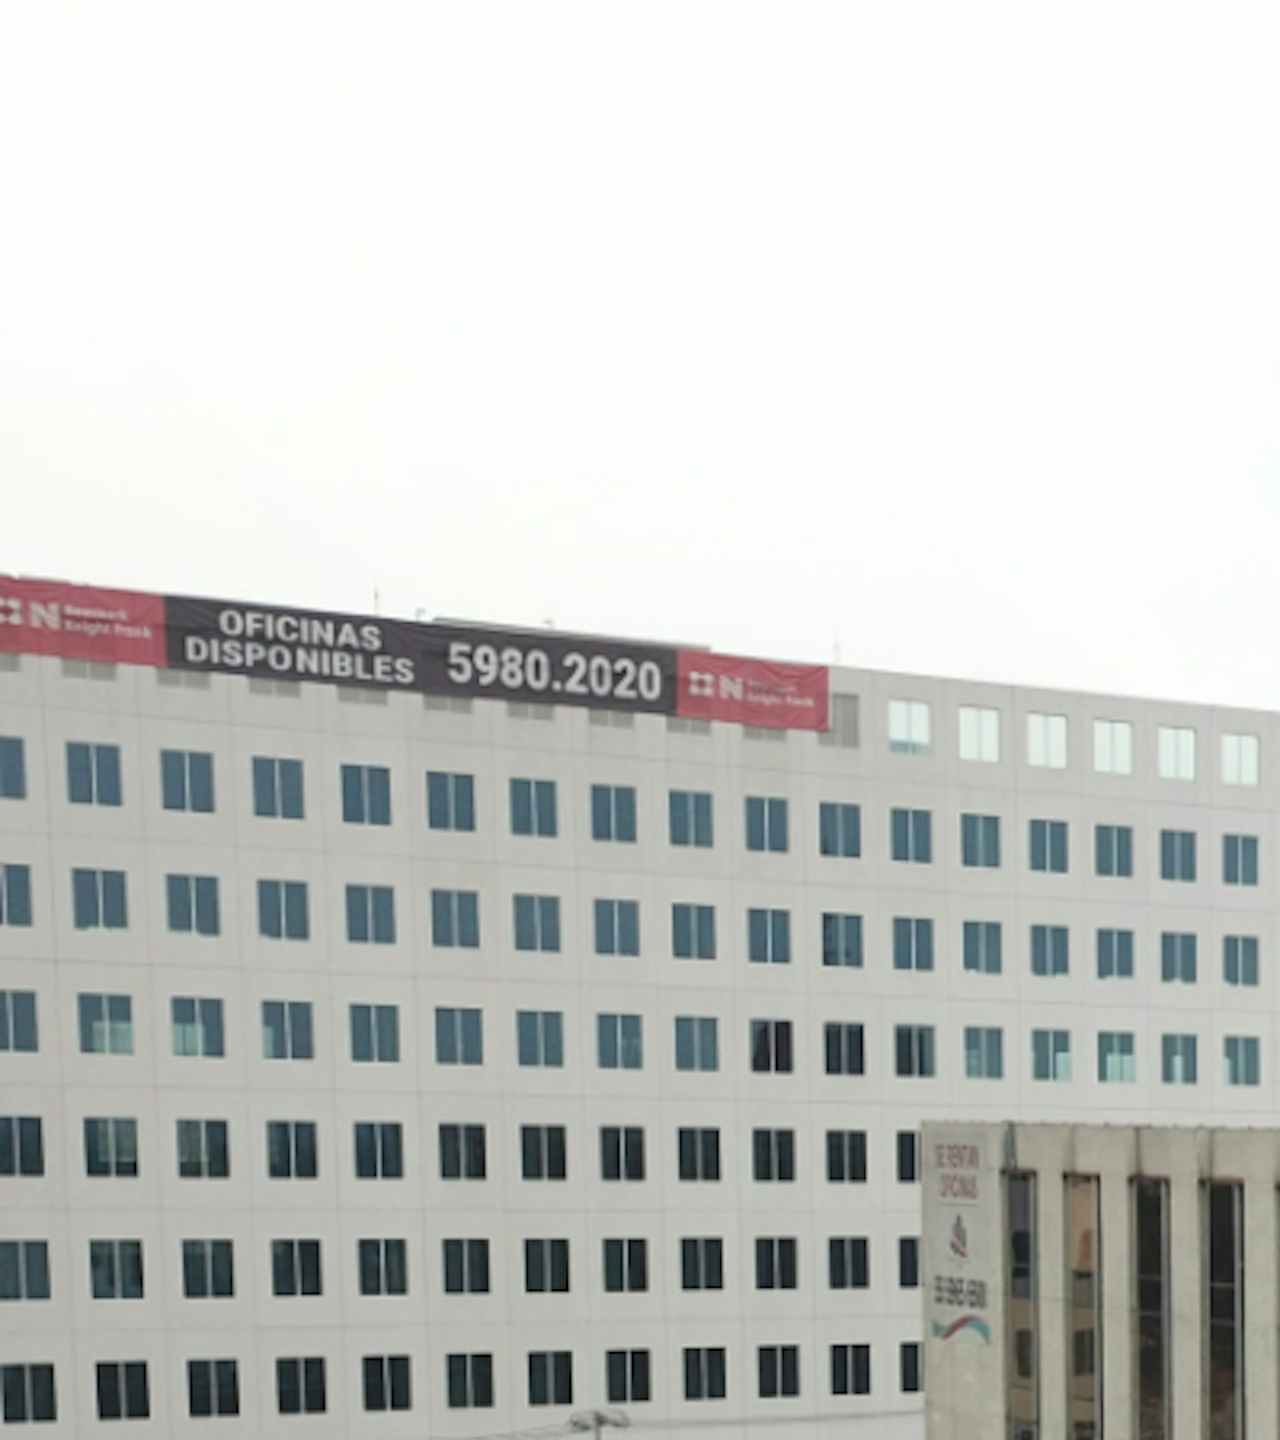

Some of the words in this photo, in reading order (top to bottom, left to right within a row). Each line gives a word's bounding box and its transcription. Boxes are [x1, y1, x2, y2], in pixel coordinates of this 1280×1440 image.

[218, 609, 383, 651] OFICINAS
[184, 636, 416, 684] DISPONIBLES
[447, 642, 662, 701] 5980.2020
